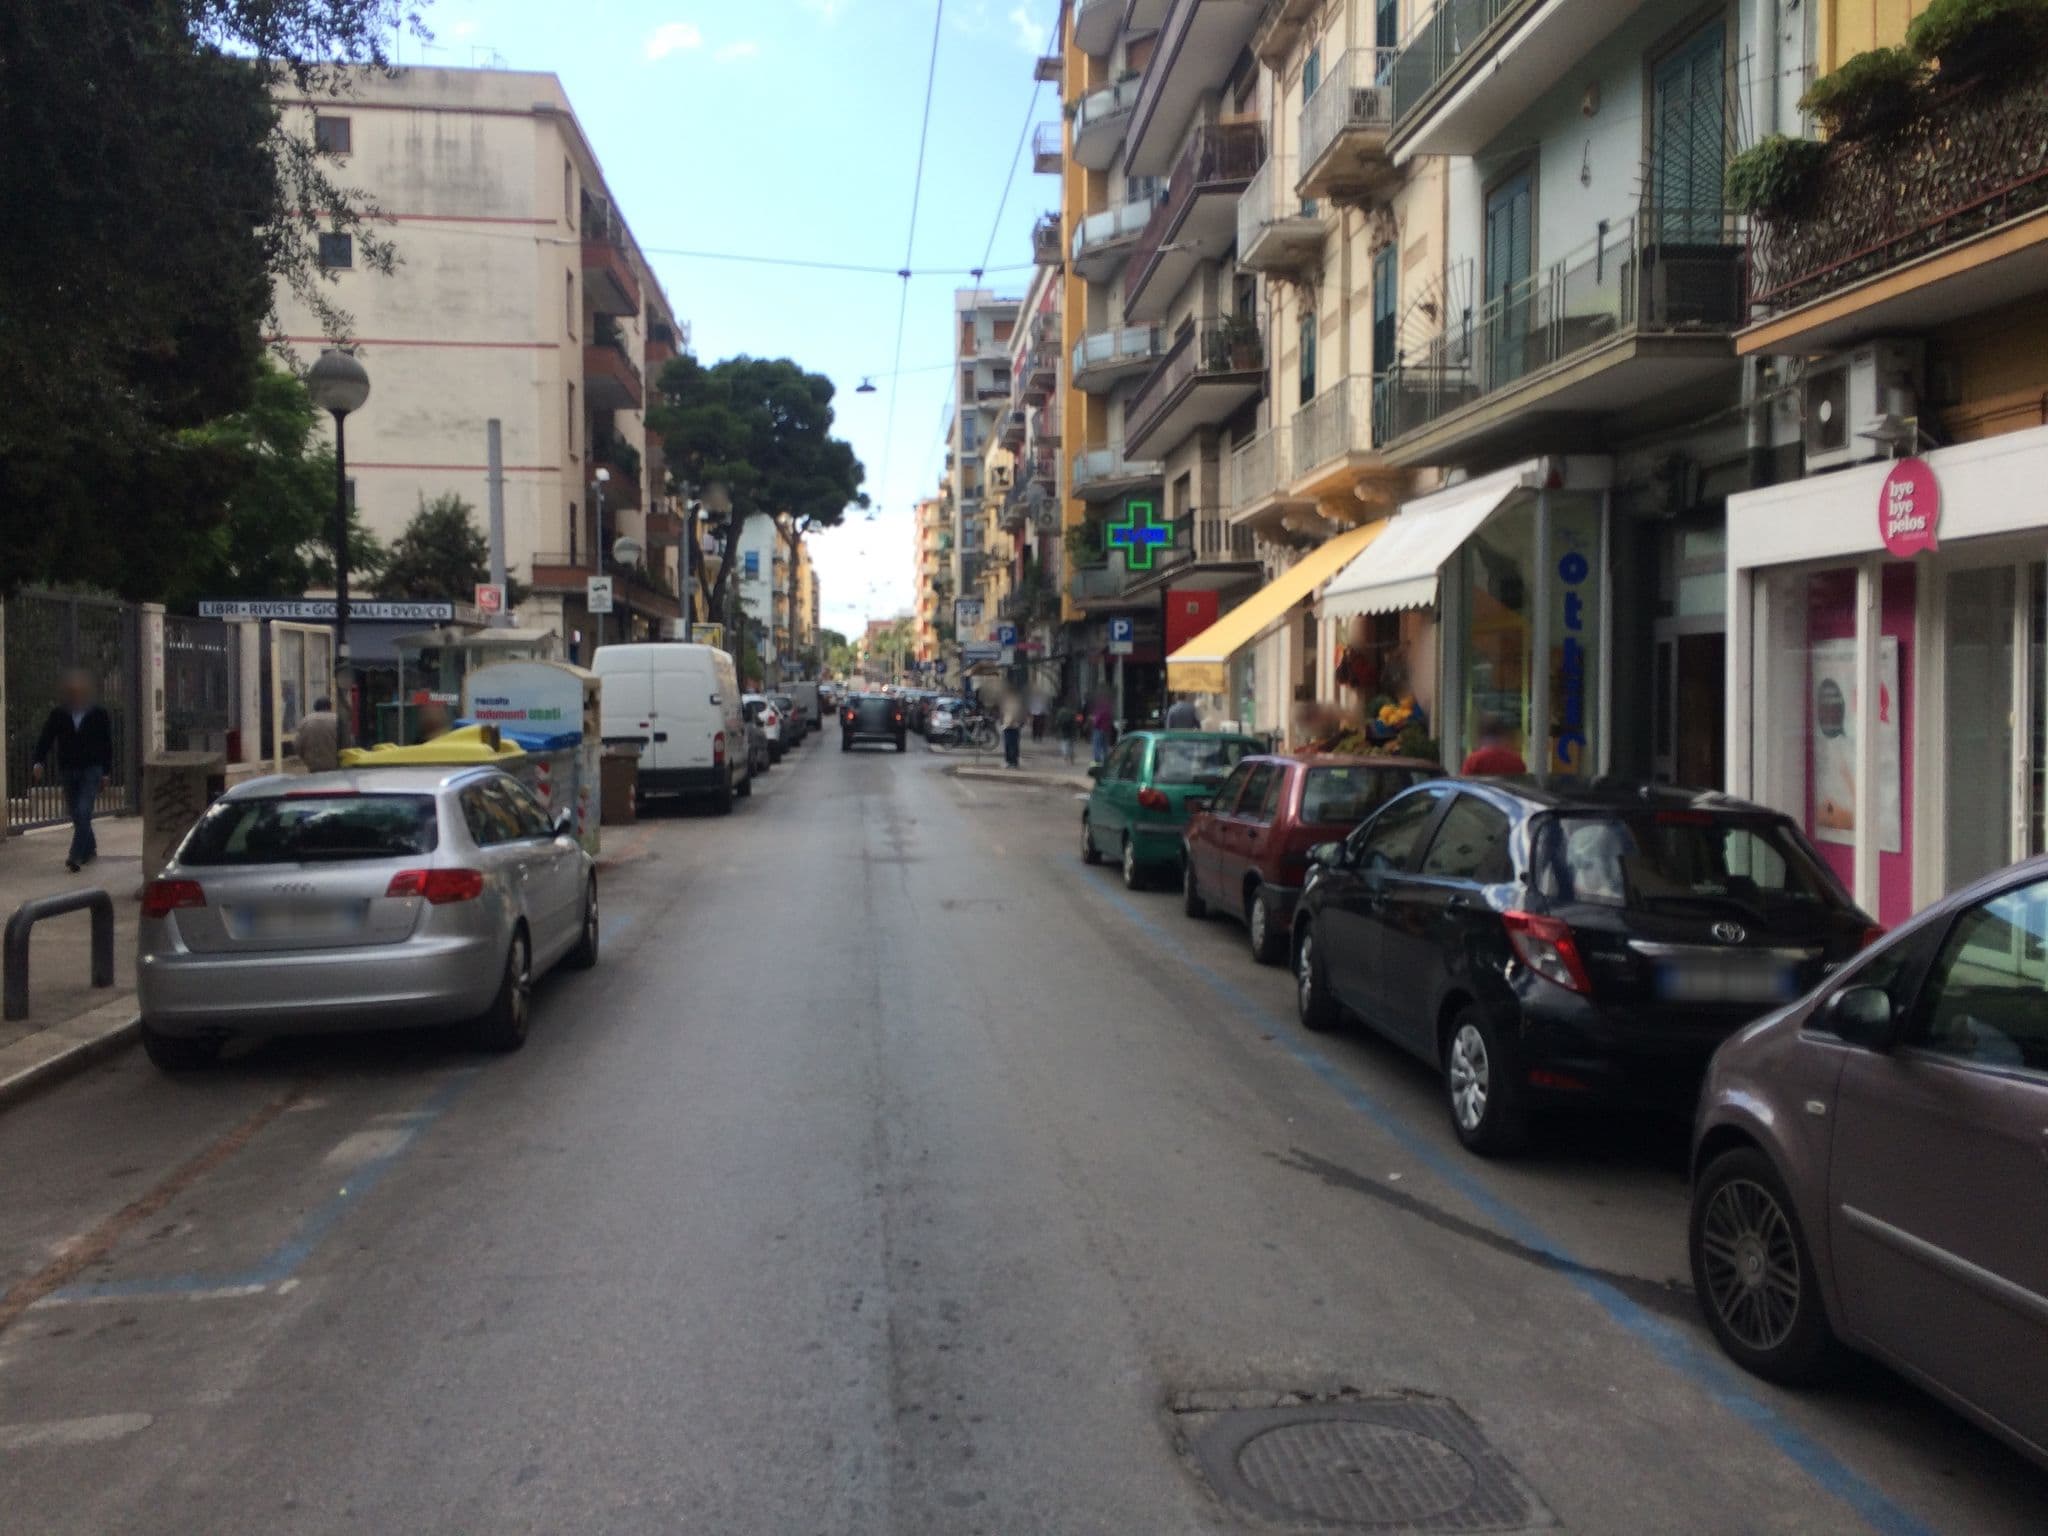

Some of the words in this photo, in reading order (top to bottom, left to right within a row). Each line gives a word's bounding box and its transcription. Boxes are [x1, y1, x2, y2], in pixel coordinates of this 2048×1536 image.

[1889, 480, 1915, 500] bye
[1888, 499, 1914, 519] bye
[1888, 514, 1926, 539] pelos
[203, 602, 239, 615] LIBRI
[249, 603, 302, 616] RIVISTE
[312, 604, 380, 617] GIONALI
[1001, 627, 1013, 645] P
[1114, 619, 1129, 641] P
